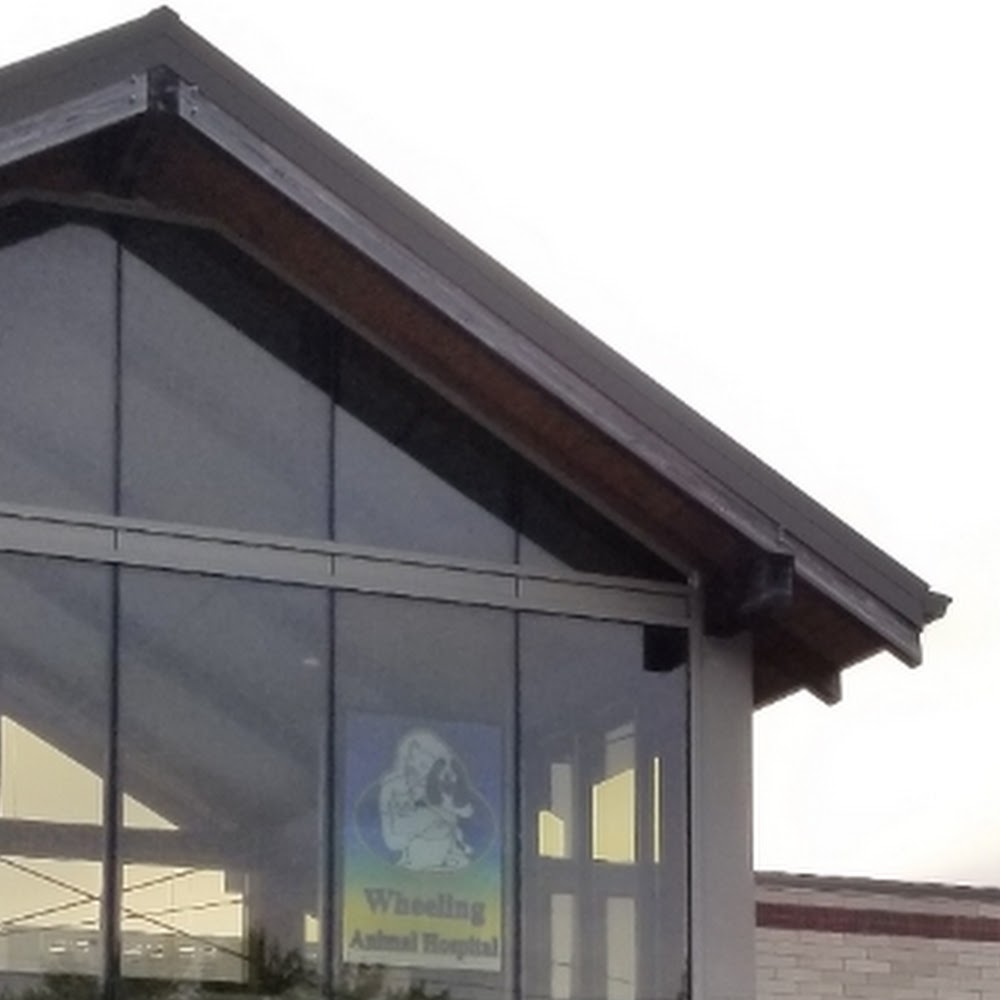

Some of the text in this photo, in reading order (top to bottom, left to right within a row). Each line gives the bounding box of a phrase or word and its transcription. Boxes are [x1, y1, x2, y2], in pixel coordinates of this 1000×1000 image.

[364, 887, 487, 927] Wheeling
[350, 930, 499, 960] Animal Hospital
